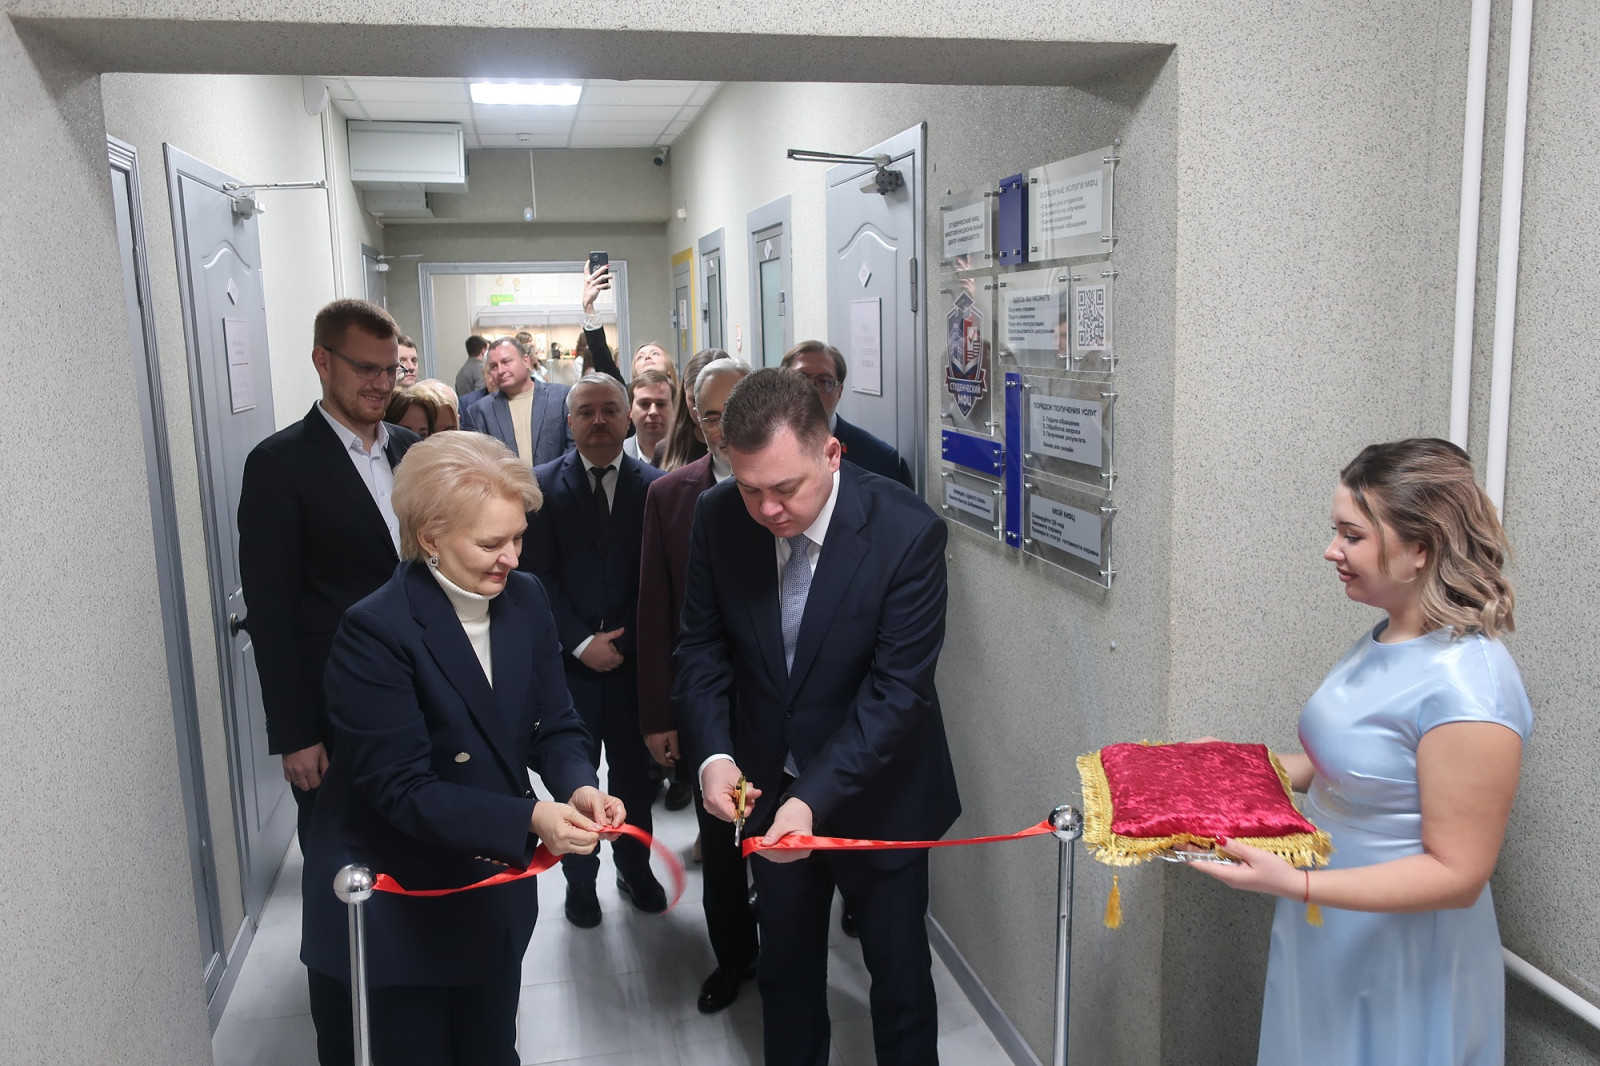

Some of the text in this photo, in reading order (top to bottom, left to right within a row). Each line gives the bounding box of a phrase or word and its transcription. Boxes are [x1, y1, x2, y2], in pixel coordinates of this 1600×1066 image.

[1066, 181, 1084, 192] УСЛУГИ
[1085, 179, 1098, 188] МФЦ
[950, 383, 980, 393] СТУДЕНЧЕСКИЙ
[958, 394, 972, 407] МФЦ
[1033, 402, 1097, 417] ПОРЯДОК ПОЛУЧЕНИЯ УСЛУГ
[1052, 507, 1075, 522] МОЙ МФЦ
